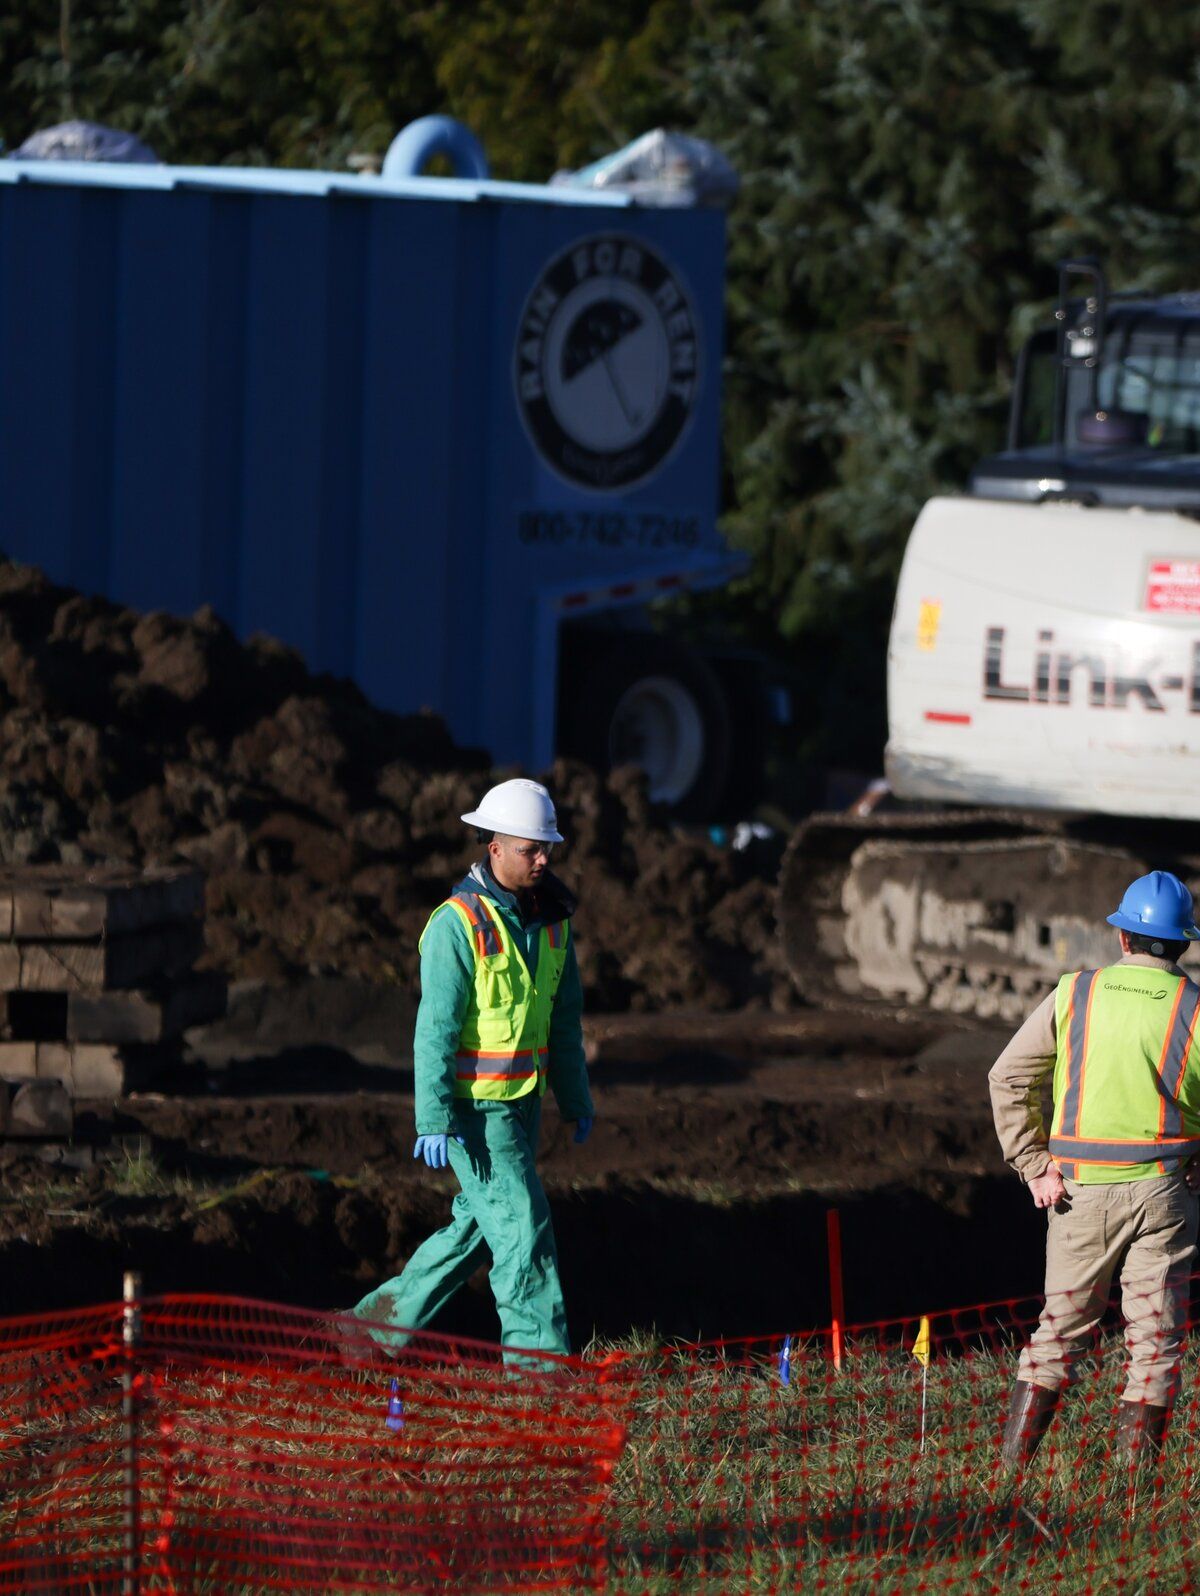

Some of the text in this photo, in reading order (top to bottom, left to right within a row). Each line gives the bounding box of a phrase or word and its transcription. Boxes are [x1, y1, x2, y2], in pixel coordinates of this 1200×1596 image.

[520, 242, 695, 406] RAIN FOR RENT
